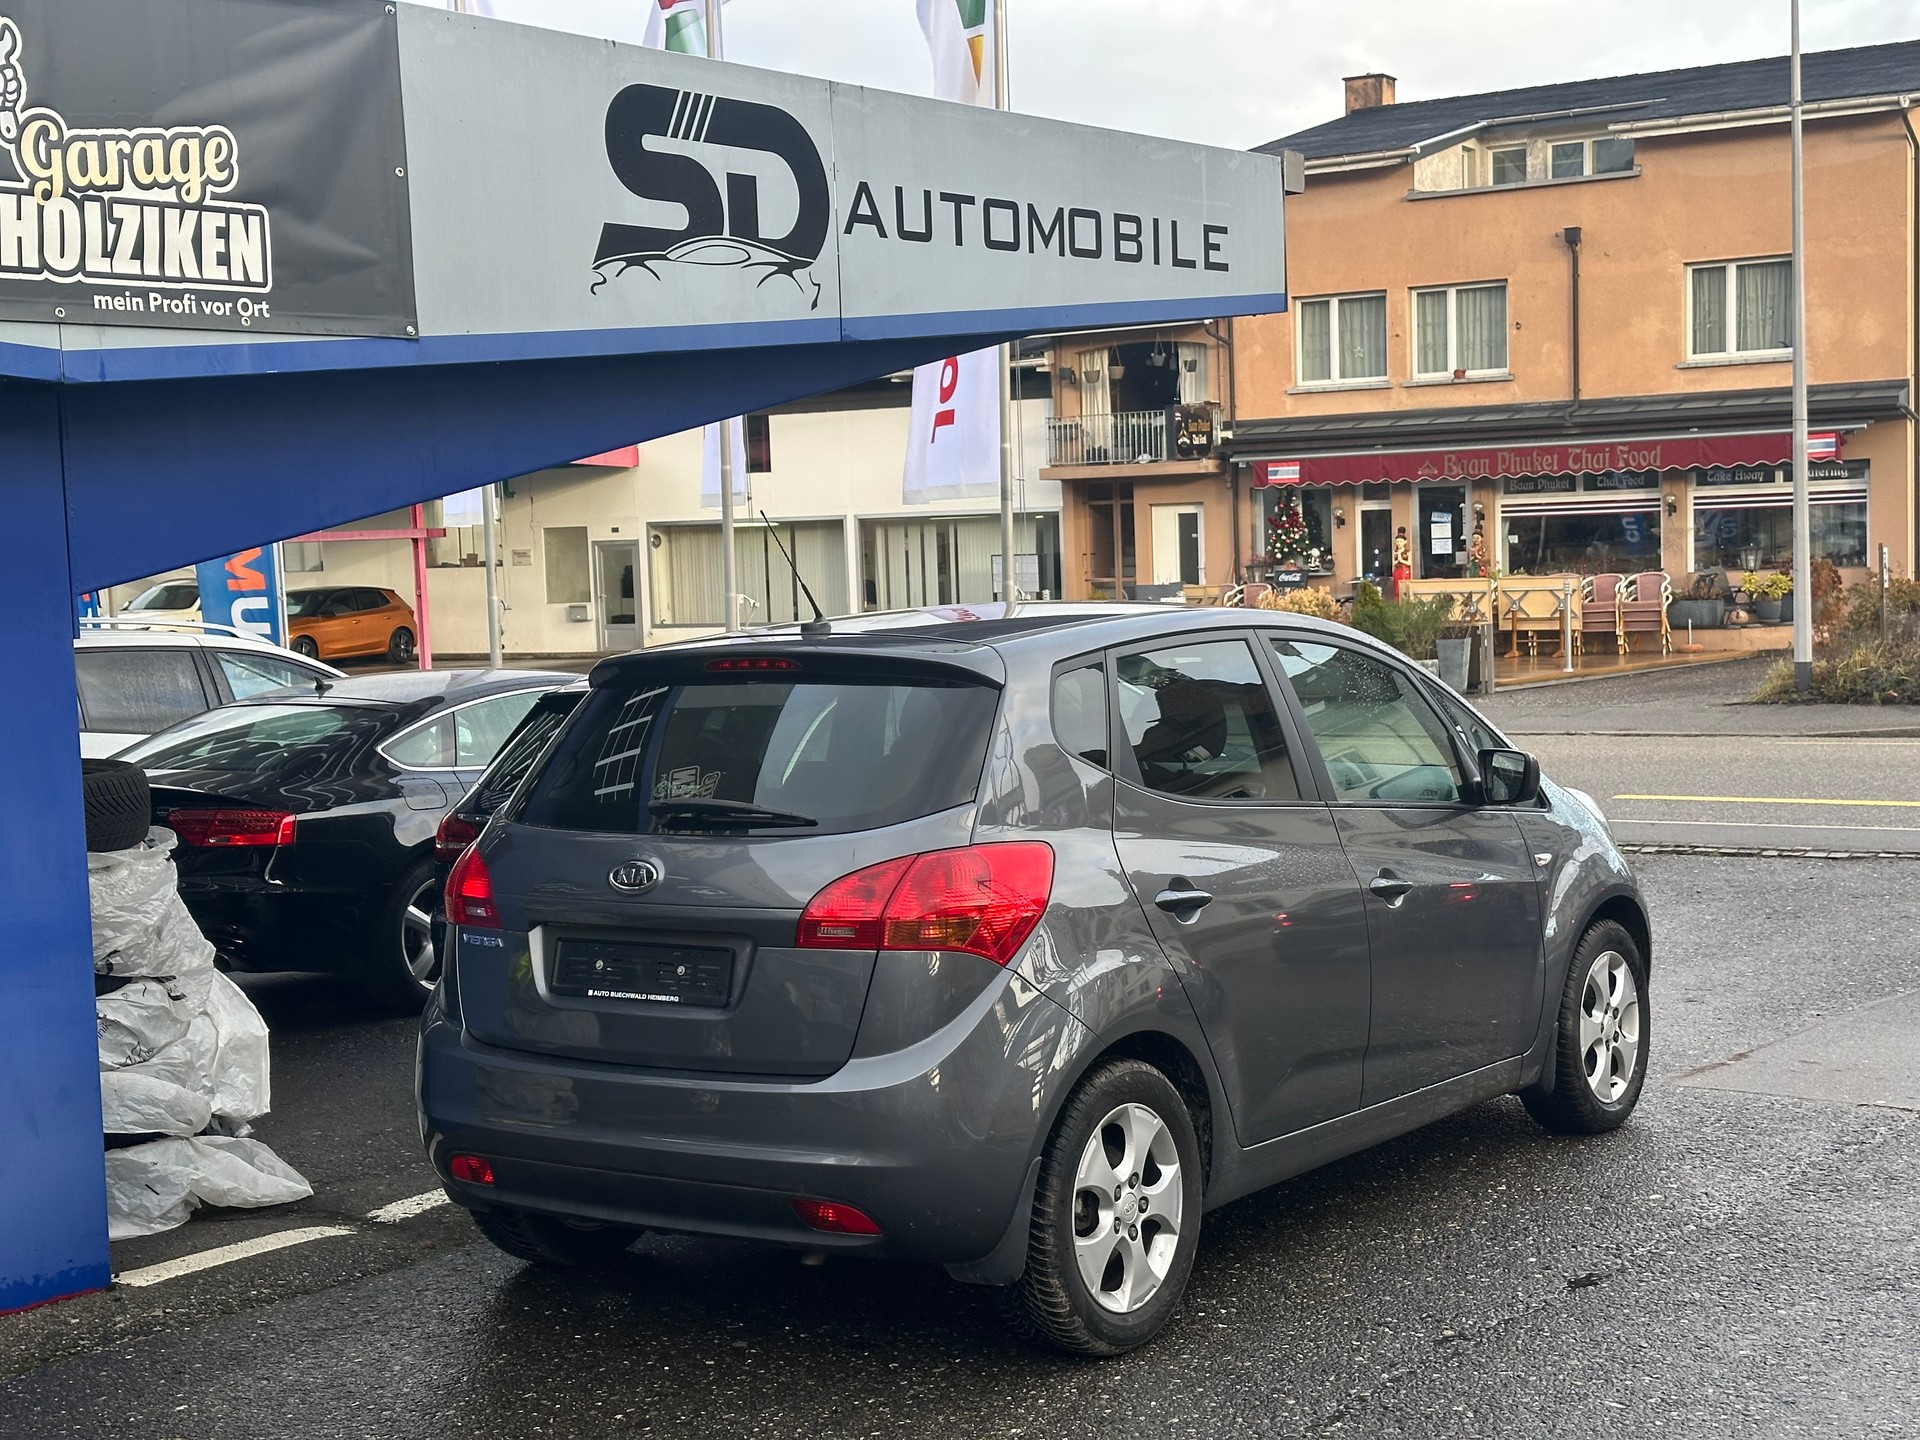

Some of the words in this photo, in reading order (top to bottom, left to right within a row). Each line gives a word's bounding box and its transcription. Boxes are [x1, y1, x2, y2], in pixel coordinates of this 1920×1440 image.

[20, 119, 232, 205] Garage
[0, 191, 267, 284] HOLZIKEN
[843, 181, 1230, 272] AUTOMOBILE
[93, 290, 145, 312] mein
[148, 292, 197, 315] Profi
[200, 299, 233, 316] vor
[236, 297, 271, 318] Ort
[1443, 453, 1490, 476] Baan
[1496, 449, 1560, 473] Phuket
[1567, 446, 1611, 470] Thai
[1616, 444, 1662, 468] Food
[1509, 479, 1535, 491] Baan
[1537, 477, 1570, 491] Phuket
[1596, 475, 1619, 488] Thai
[1621, 474, 1645, 488] Food
[1734, 470, 1764, 483] Away
[616, 867, 648, 884] KIA
[593, 989, 610, 997] AUTO
[610, 991, 647, 1000] BUECHWALD
